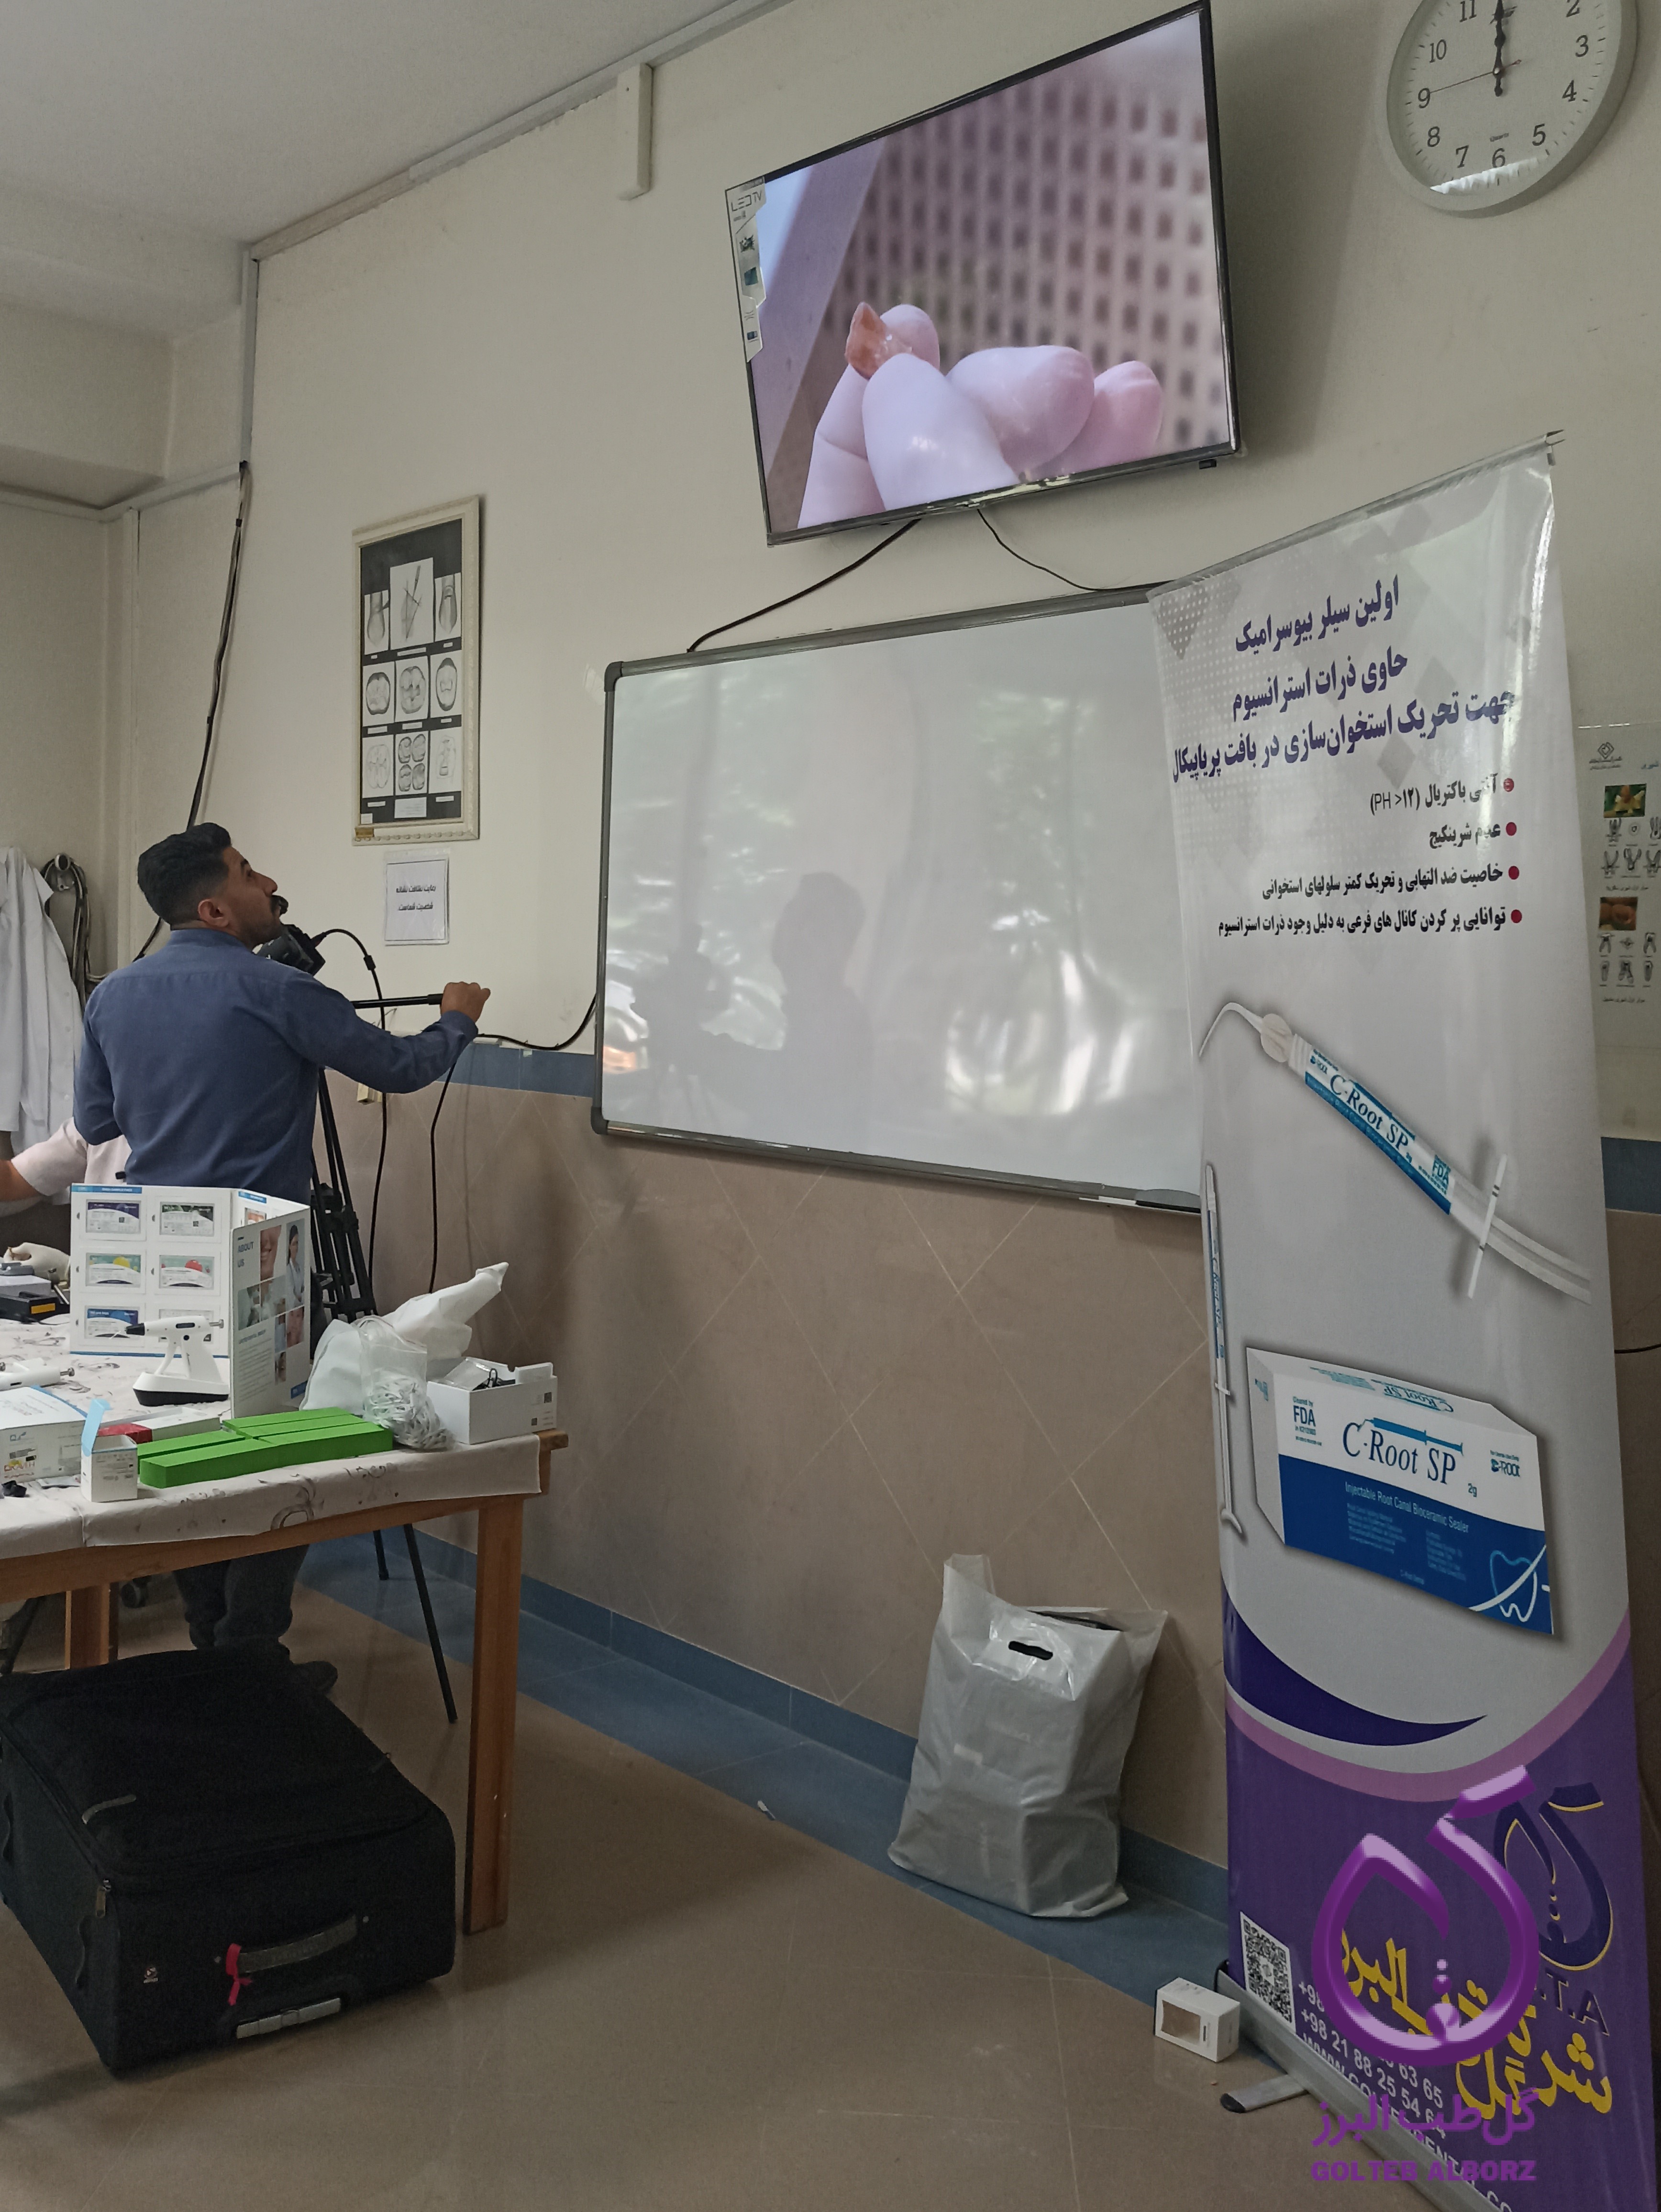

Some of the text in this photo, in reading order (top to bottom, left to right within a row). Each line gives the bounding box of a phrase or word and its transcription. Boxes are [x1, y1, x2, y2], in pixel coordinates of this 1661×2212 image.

[1460, 0, 1477, 22] 11
[1566, 0, 1580, 17] 2
[1429, 39, 1447, 63] 10
[1575, 35, 1589, 57] 3
[1418, 88, 1431, 108] 9
[1562, 80, 1577, 102] 4
[1427, 127, 1440, 147] 8
[1532, 123, 1546, 146] 5
[1456, 145, 1469, 168] 7
[1492, 148, 1505, 168] 6
[1235, 574, 1398, 655] اولین سیلر بیوسرامیک
[1233, 645, 1407, 722] حاوی ذرات استرانسیوم
[1398, 691, 1459, 739] تحریک
[1465, 691, 1515, 724] جهت
[1225, 732, 1256, 768] بافت
[1262, 735, 1279, 768] در
[1173, 743, 1220, 783] پریاپیکال
[1425, 781, 1465, 808] باکتریال
[1343, 873, 1362, 896] کمتر
[1365, 871, 1395, 894] تحریک
[1398, 877, 1403, 893] و
[1406, 867, 1438, 892] التهابی
[1440, 866, 1457, 885] ضد
[1461, 863, 1503, 887] خاصیت
[1262, 877, 1302, 900] استخوانی
[1218, 907, 1506, 937] توانایی پر کردن کانال های فرعی به دلیل وجود ذرات استرانسیوم
[1386, 1124, 1408, 1150] SP
[1293, 1405, 1316, 1427] FDA
[1428, 1448, 1456, 1484] SP
[1468, 1483, 1477, 1497] 2g
[1345, 1482, 1469, 1533] Injectable Root Canal Bioceramic Sealer
[1301, 2009, 1327, 2040] +98
[1332, 2030, 1348, 2058] 21
[1354, 2048, 1373, 2077] 88
[1377, 2068, 1396, 2097] 25
[1402, 2087, 1420, 2118] 54
[1423, 2078, 1443, 2108] 65
